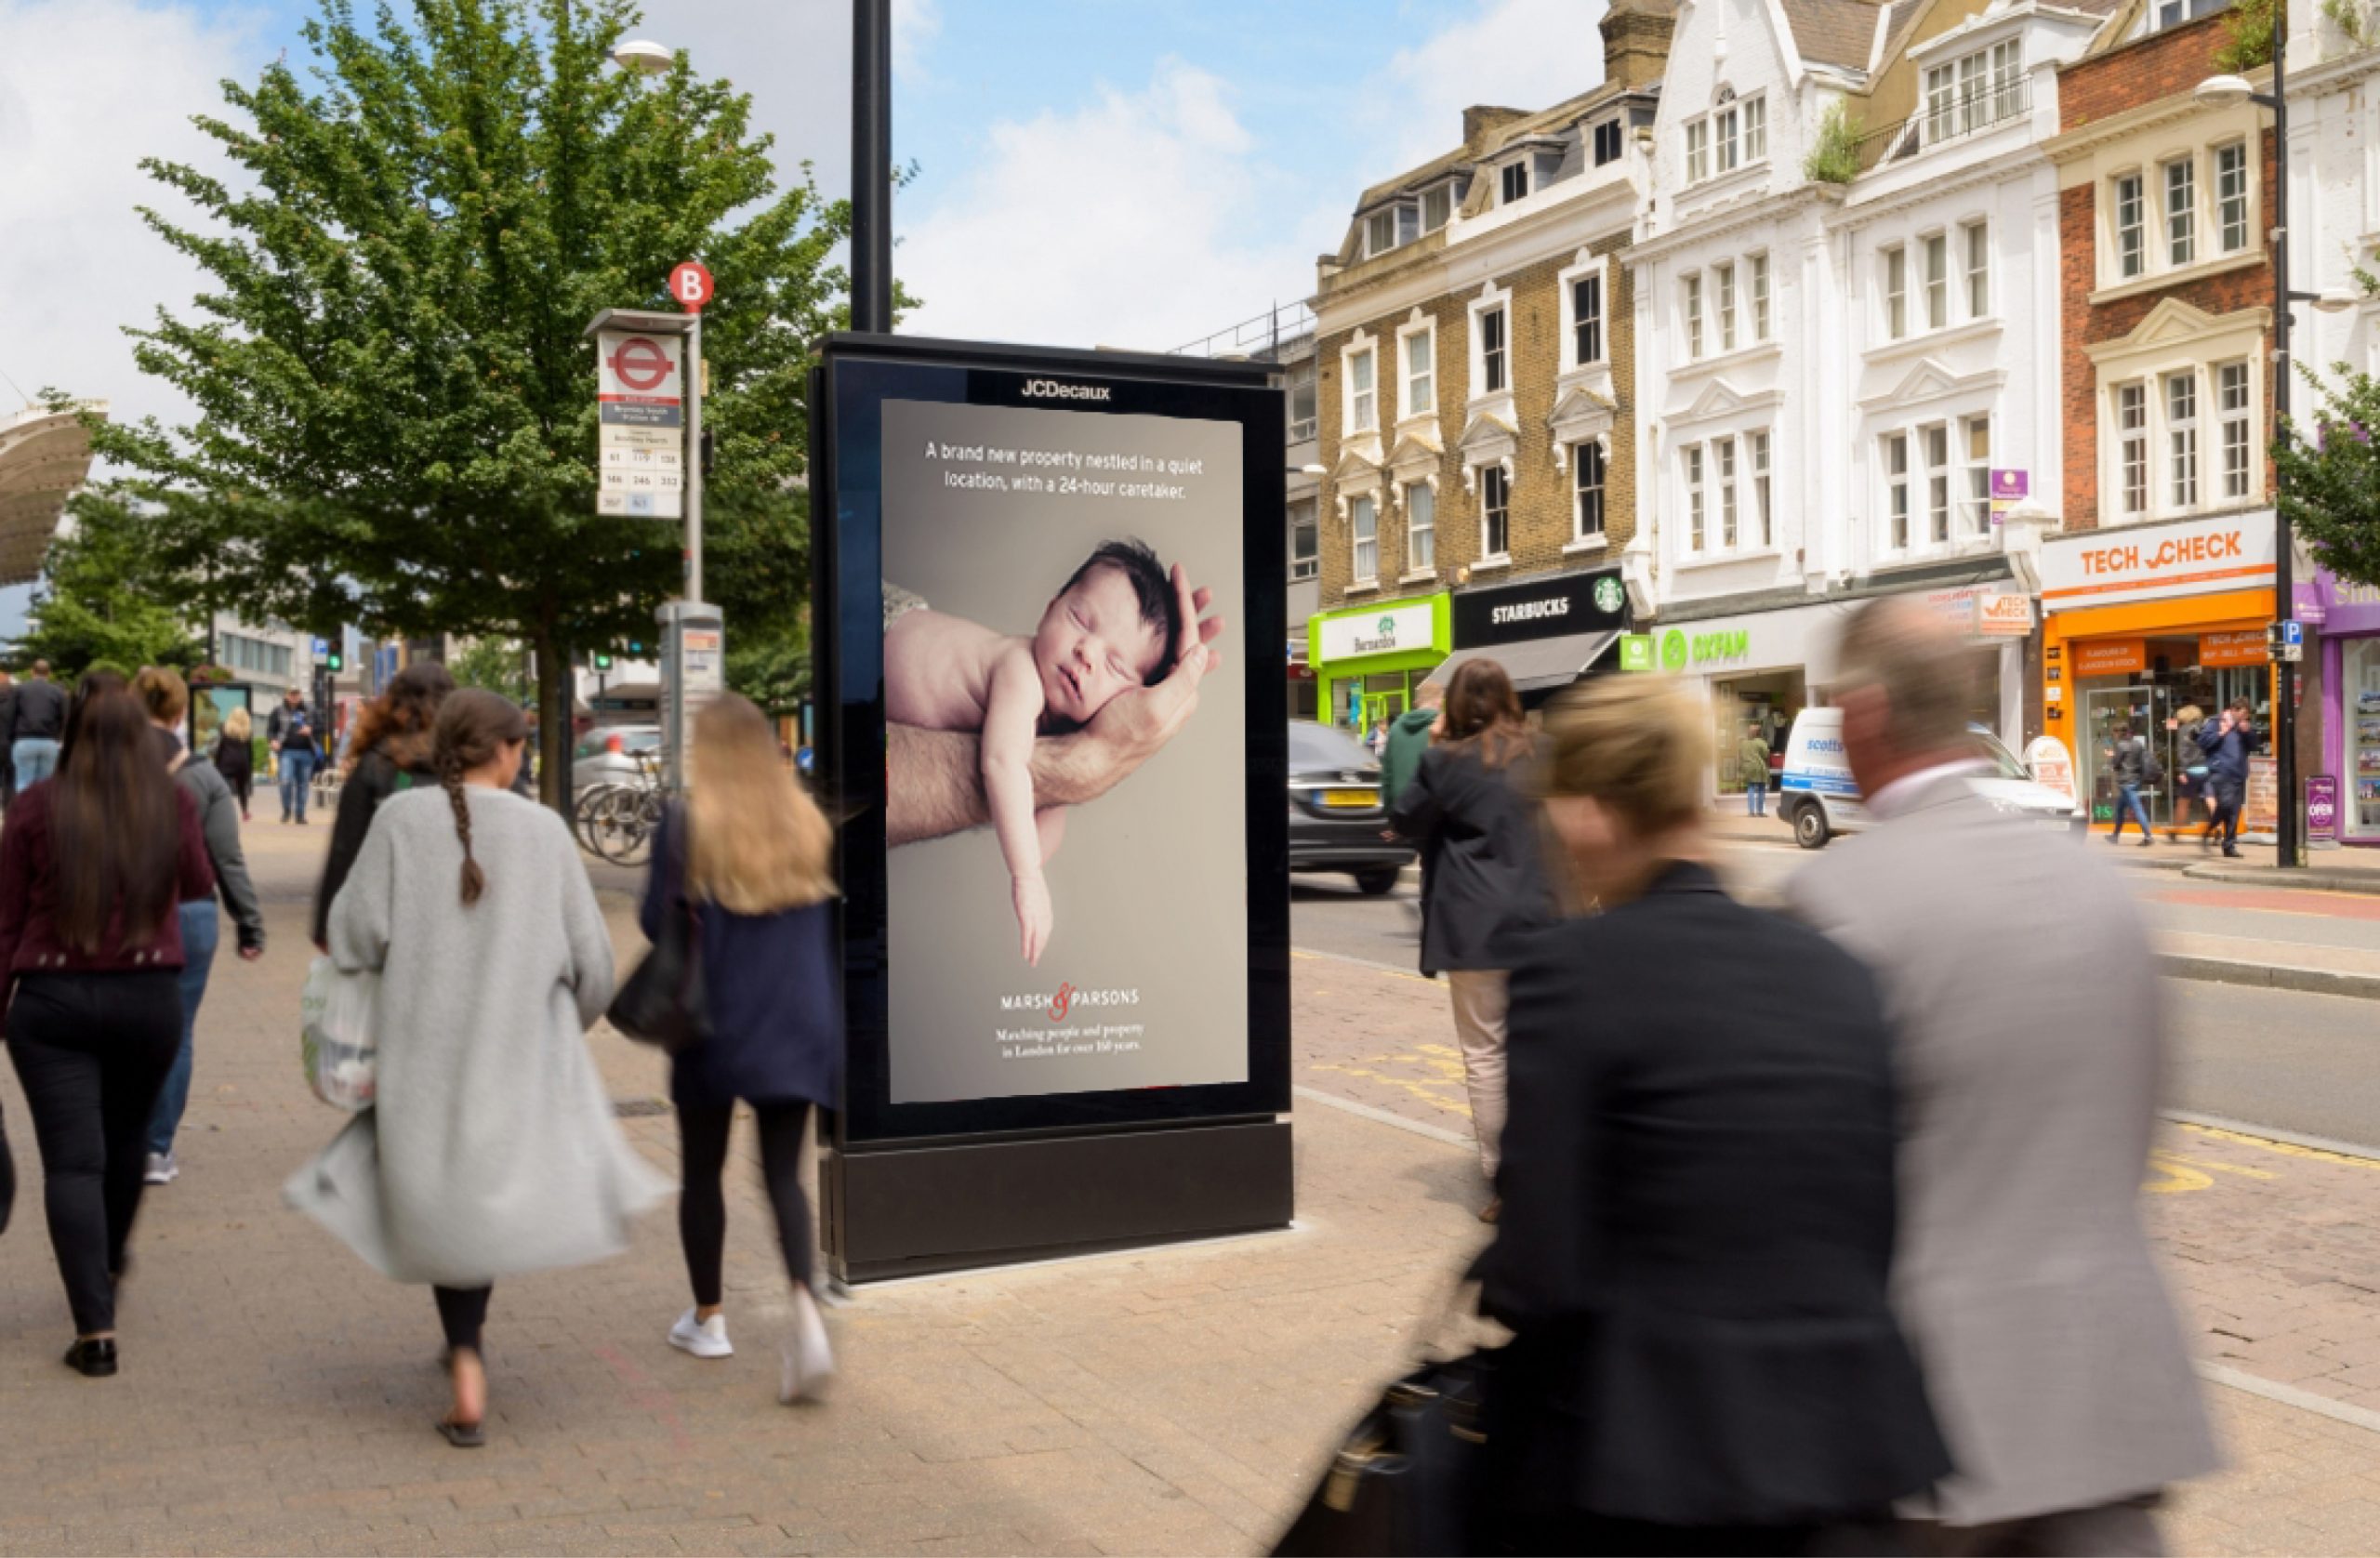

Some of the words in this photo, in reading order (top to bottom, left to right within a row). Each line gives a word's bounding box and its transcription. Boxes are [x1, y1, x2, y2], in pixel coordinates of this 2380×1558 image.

[681, 269, 704, 300] B
[1022, 379, 1111, 401] JCDecaux
[925, 441, 937, 459] A
[941, 443, 984, 461] brand
[986, 447, 1017, 463] new
[1019, 450, 1082, 471] property
[1086, 453, 1138, 470] nestled
[1140, 455, 1154, 471] in
[1157, 458, 1165, 472] a
[1168, 456, 1204, 476] quiet
[945, 470, 1008, 492] location,
[1011, 473, 1042, 491] with
[1046, 478, 1054, 493] a
[1059, 475, 1116, 495] 24-hour
[1118, 482, 1186, 499] caretaker.
[2081, 545, 2138, 575] TECH
[2154, 531, 2241, 566] CHECK
[1491, 597, 1569, 624] STARBUCKS
[2289, 623, 2299, 643] P
[1692, 629, 1749, 663] OXFAM
[2307, 803, 2332, 816] OPEN
[1000, 993, 1053, 1010] MARSH
[1071, 988, 1140, 1006] PARSONS
[1047, 1025, 1079, 1042] people
[1082, 1023, 1101, 1036] and
[1104, 1023, 1145, 1039] property
[1002, 1045, 1012, 1059] in
[1015, 1044, 1054, 1058] London
[1057, 1041, 1071, 1054] for
